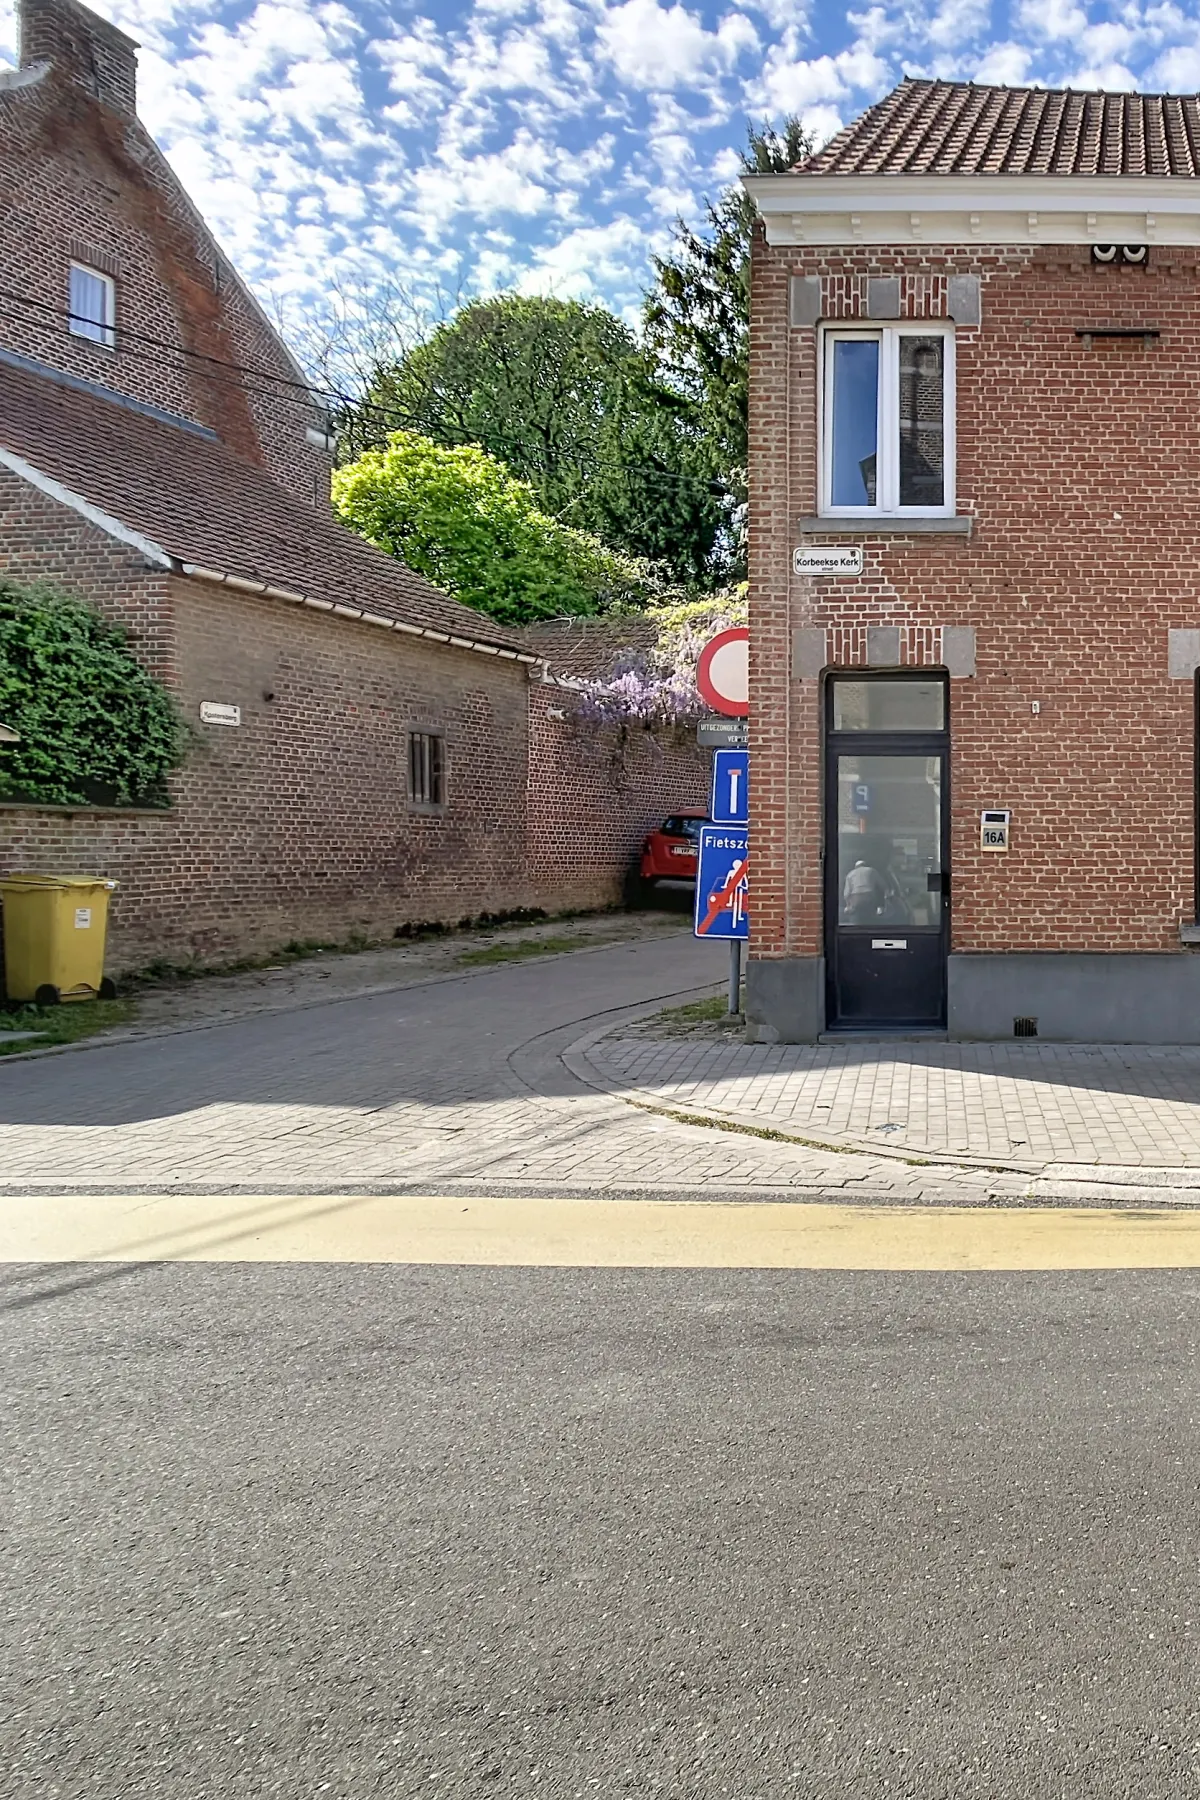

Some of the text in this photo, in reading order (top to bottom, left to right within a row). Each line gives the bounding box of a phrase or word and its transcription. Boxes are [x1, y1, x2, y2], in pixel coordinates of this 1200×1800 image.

[796, 558, 859, 566] Korbeekse Kerk
[984, 831, 1005, 843] 16A
